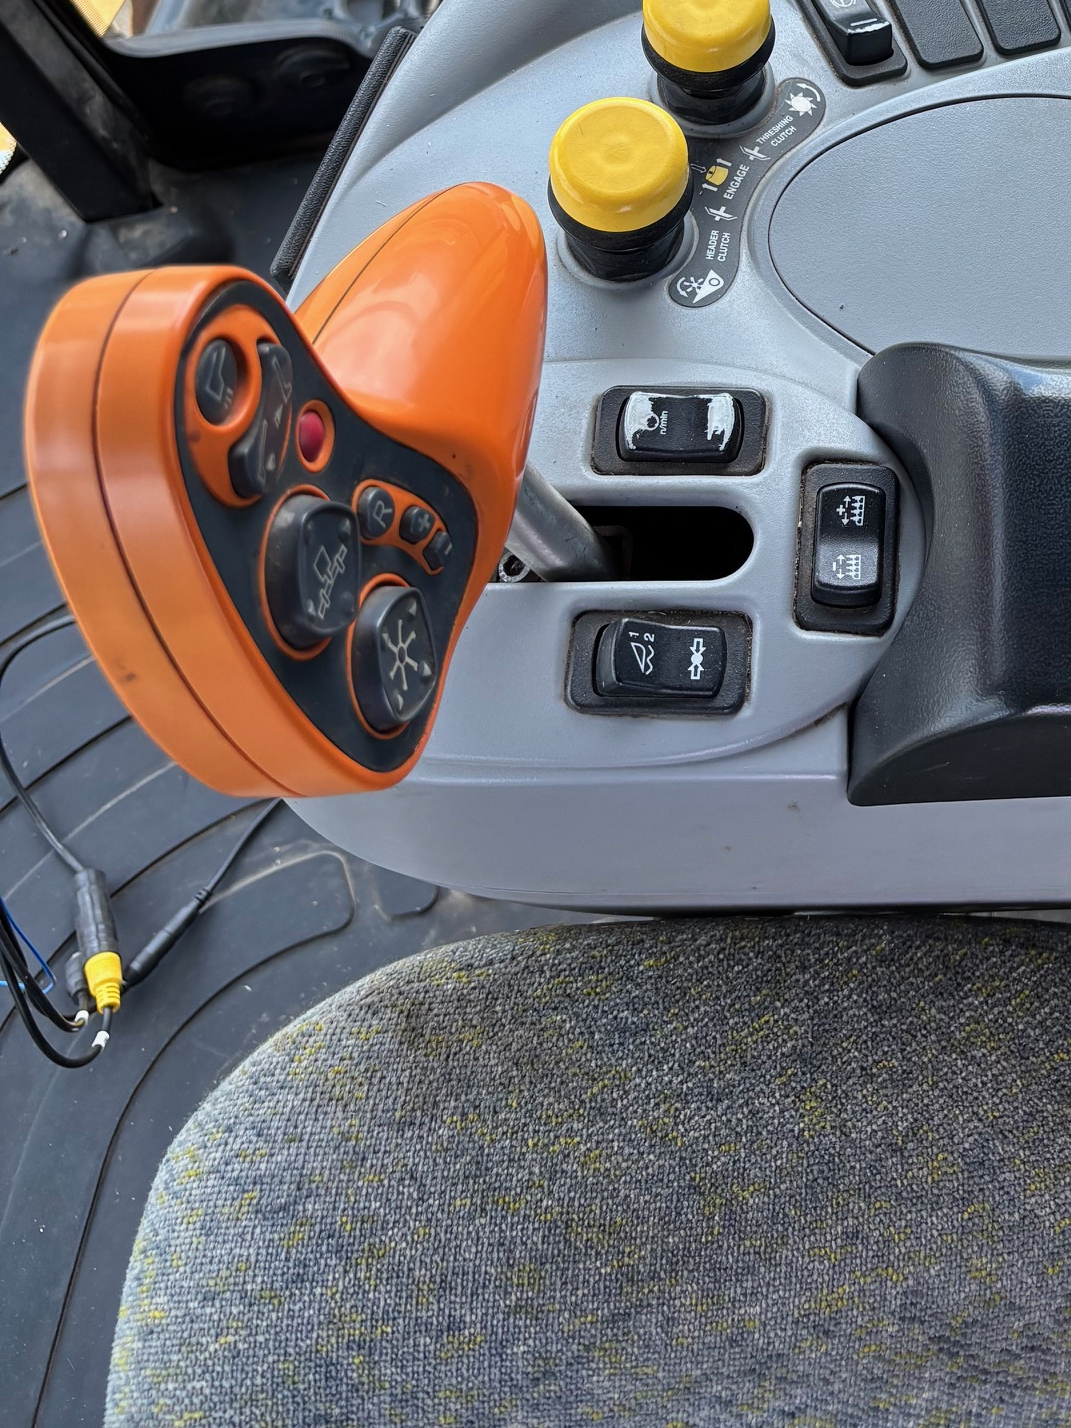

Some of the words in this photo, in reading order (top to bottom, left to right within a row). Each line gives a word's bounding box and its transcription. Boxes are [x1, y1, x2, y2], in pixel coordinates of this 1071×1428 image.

[756, 115, 794, 145] THRESHING
[770, 125, 797, 148] CLUTCH
[723, 164, 750, 200] ENGAGE
[705, 229, 719, 260] HEADER
[717, 232, 731, 262] CLUTCH
[373, 500, 393, 529] R
